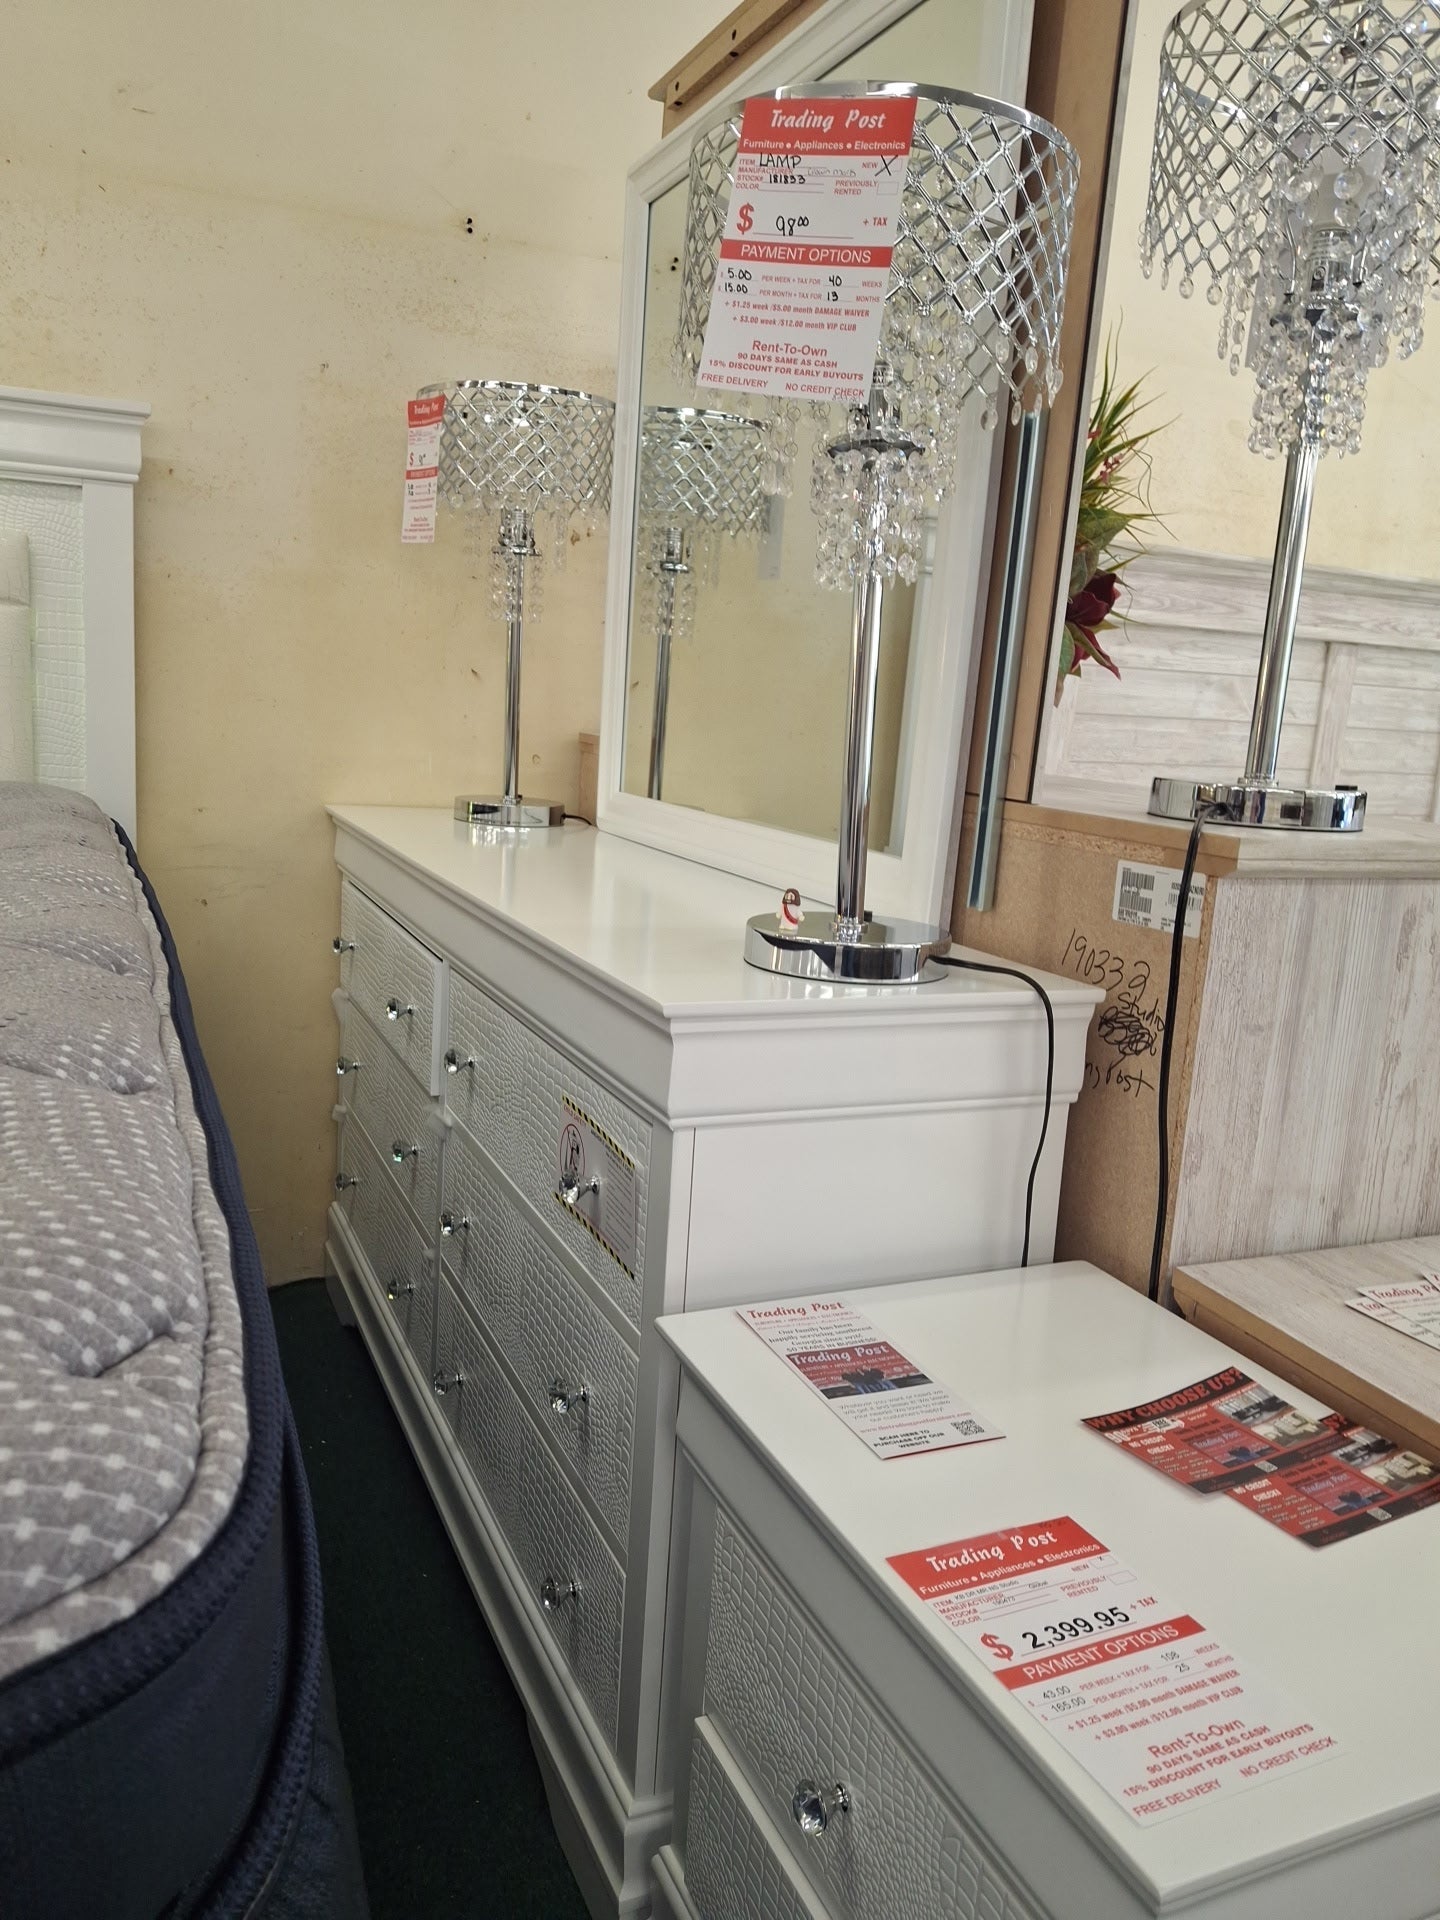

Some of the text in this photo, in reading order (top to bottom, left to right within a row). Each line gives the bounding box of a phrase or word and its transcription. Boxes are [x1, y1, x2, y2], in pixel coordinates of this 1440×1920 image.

[771, 110, 886, 132] Trading Post
[743, 138, 906, 150] Furniture Appliances Electronics
[739, 152, 802, 169] ITEM LAMP
[862, 161, 878, 169] NEW
[736, 182, 760, 190] COLOR
[769, 174, 806, 184] 181833
[835, 180, 878, 188] PREVIOUSLY
[834, 188, 862, 196] RENTED
[736, 202, 754, 234] $
[872, 217, 888, 226] TAX
[741, 244, 872, 264] PAYMENT OPTIONS
[726, 267, 752, 280] 5.00
[827, 275, 843, 286] 40
[861, 280, 882, 288] WEEKS
[723, 282, 748, 293] 15.00
[826, 291, 839, 301] 13
[752, 302, 769, 310] week
[792, 305, 813, 313] month
[814, 307, 841, 315] DAMAGE
[844, 309, 869, 317] WAIVER
[804, 321, 824, 329] month
[751, 340, 828, 356] Rent-To-Own
[708, 359, 726, 367] 15%
[728, 361, 773, 372] DISCOUNT
[774, 366, 792, 374] FOR
[793, 368, 820, 376] EARLY
[822, 371, 863, 381] BUYOUTS
[750, 354, 772, 362] DAYS
[774, 356, 798, 364] SAME
[813, 360, 837, 368] CASH
[701, 373, 864, 396] FREE DELIVERY NO CREDIT CHECK
[1118, 992, 1166, 1032] Studio
[747, 1302, 844, 1318] Trading Post
[790, 1345, 890, 1366] Trading Post
[1086, 1410, 1138, 1429] WHY
[1136, 1384, 1210, 1418] CHOOSE
[1208, 1368, 1244, 1391] US?
[874, 1438, 913, 1448] PURCHASE
[900, 1430, 920, 1438] HERE
[1128, 1434, 1166, 1448] NO CREDIT
[898, 1440, 931, 1448] WEBSITE
[1233, 1485, 1248, 1494] NO
[1248, 1478, 1272, 1492] CREDIT
[926, 1532, 1057, 1571] Trading Post
[920, 1542, 1101, 1594] Furniture Appliances Electronics
[1060, 1576, 1106, 1591] PREVIOUSLY
[1067, 1586, 1100, 1597] RENTED
[933, 1599, 953, 1608] ITEM
[939, 1594, 1003, 1614] MANUFACTURER
[945, 1608, 978, 1620] STOCK#
[952, 1616, 981, 1626] COLOR
[981, 1597, 1158, 1661] $ 2,399.95 TAX
[1023, 1624, 1181, 1679] PAYMENT OPTIONS
[1043, 1686, 1070, 1699] 43.00
[1095, 1676, 1114, 1686] WEEK
[1193, 1643, 1221, 1654] WEEKS
[1108, 1688, 1135, 1699] MONTH
[1175, 1663, 1190, 1672] 25
[1203, 1656, 1235, 1668] MONTHS
[1075, 1715, 1101, 1728] $1.25
[1102, 1708, 1123, 1719] week
[1148, 1690, 1176, 1703] month
[1175, 1680, 1209, 1695] DAMAGE
[1210, 1670, 1239, 1684] WAIVER
[1102, 1725, 1128, 1738] $3.00
[1129, 1718, 1150, 1729] week
[1180, 1699, 1207, 1711] month
[1207, 1694, 1222, 1702] VIP
[1220, 1686, 1245, 1697] CLUB
[1148, 1720, 1244, 1757] Rent-To-Own
[1146, 1726, 1270, 1773] 90 DAYS SAME AS CASH
[1123, 1724, 1313, 1796] 15% DISCOUNT FOR EARLY BUYOUTS
[1133, 1736, 1336, 1816] FREE DELIVERY NO CREDIT CHECK
